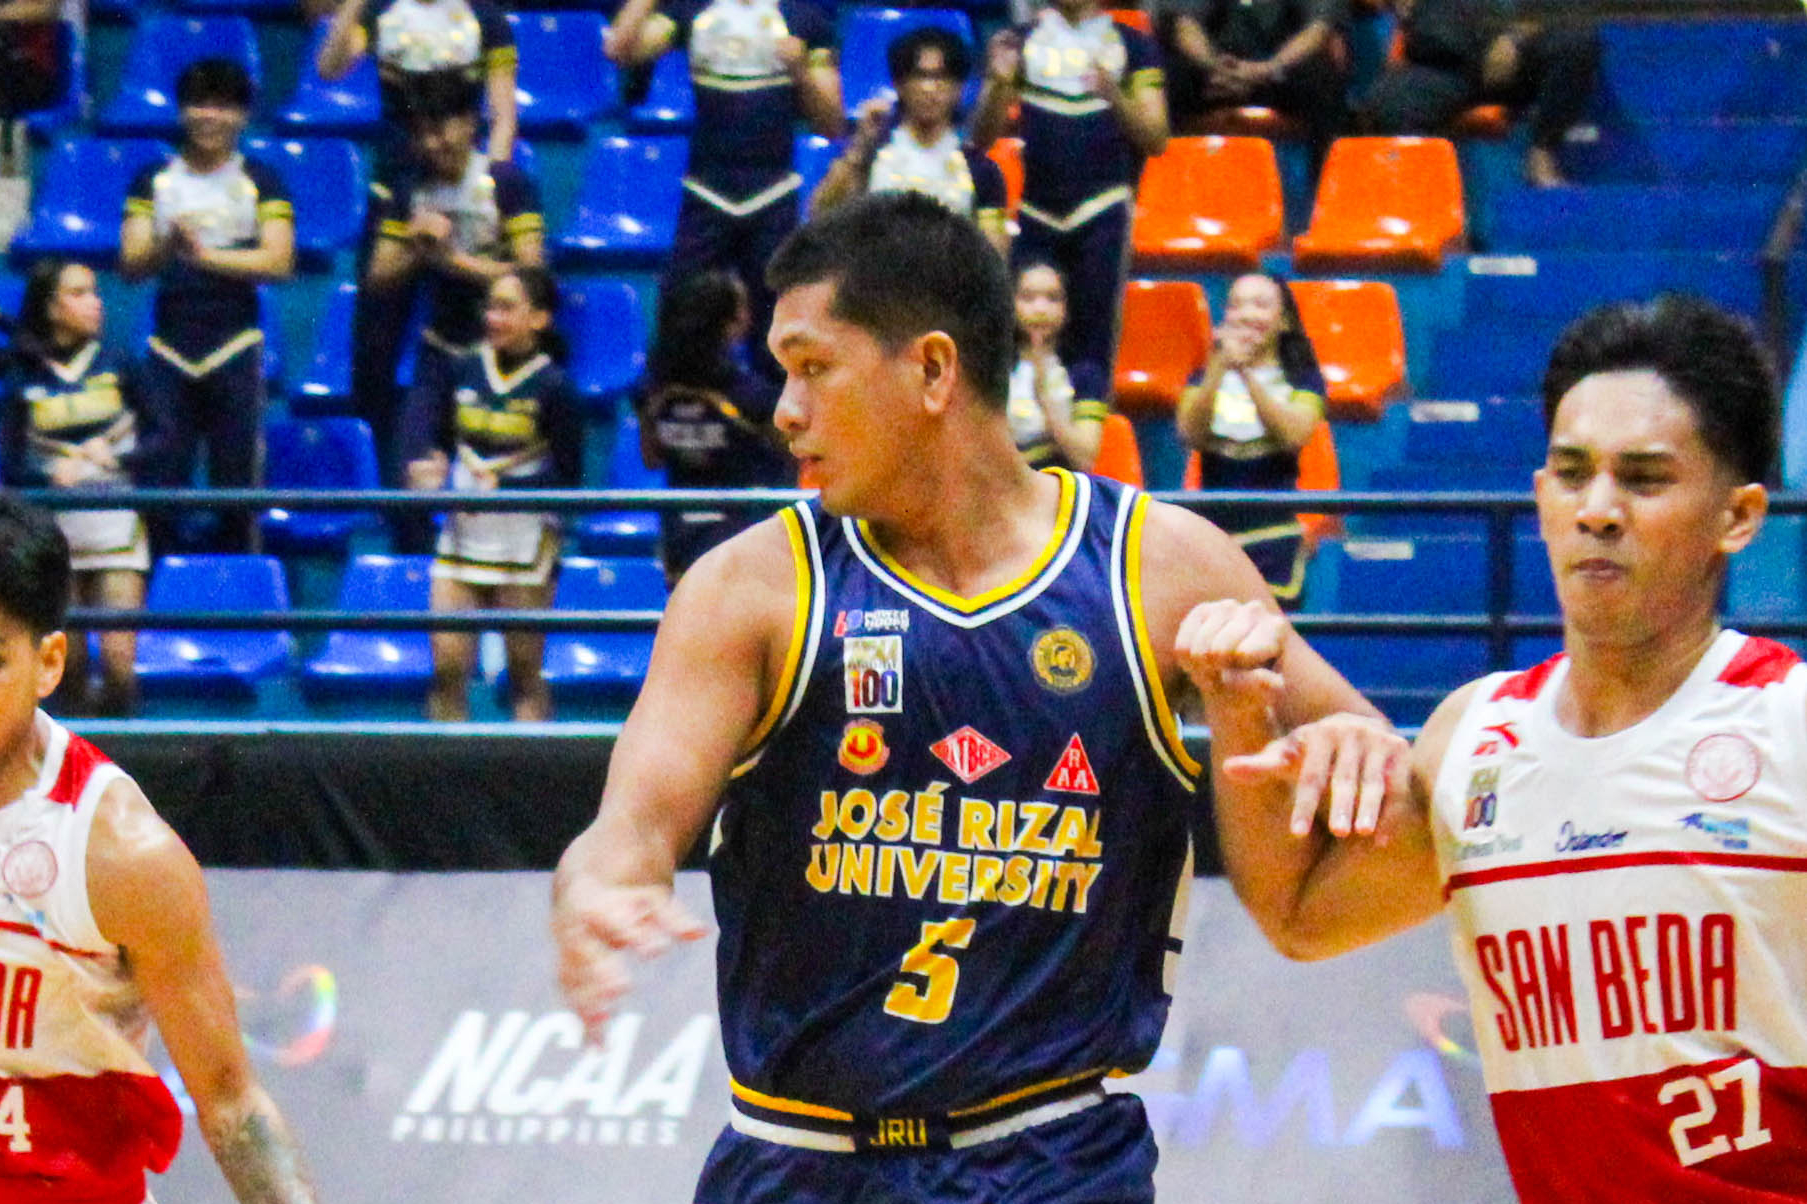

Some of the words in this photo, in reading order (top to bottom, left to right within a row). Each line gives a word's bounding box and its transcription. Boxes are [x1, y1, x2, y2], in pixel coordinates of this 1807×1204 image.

[849, 668, 899, 708] 100
[811, 782, 952, 850] JOSÉ
[958, 794, 1102, 859] RIZAL
[804, 844, 1103, 914] UNIVERSITY
[883, 917, 976, 1026] 5
[1475, 922, 1579, 1052] SAN
[1588, 912, 1738, 1041] BEDA
[405, 1009, 715, 1118] NCAA
[392, 1115, 681, 1145] PHILIPPINES
[869, 1117, 927, 1148] JRU
[1658, 1057, 1773, 1168] 27
